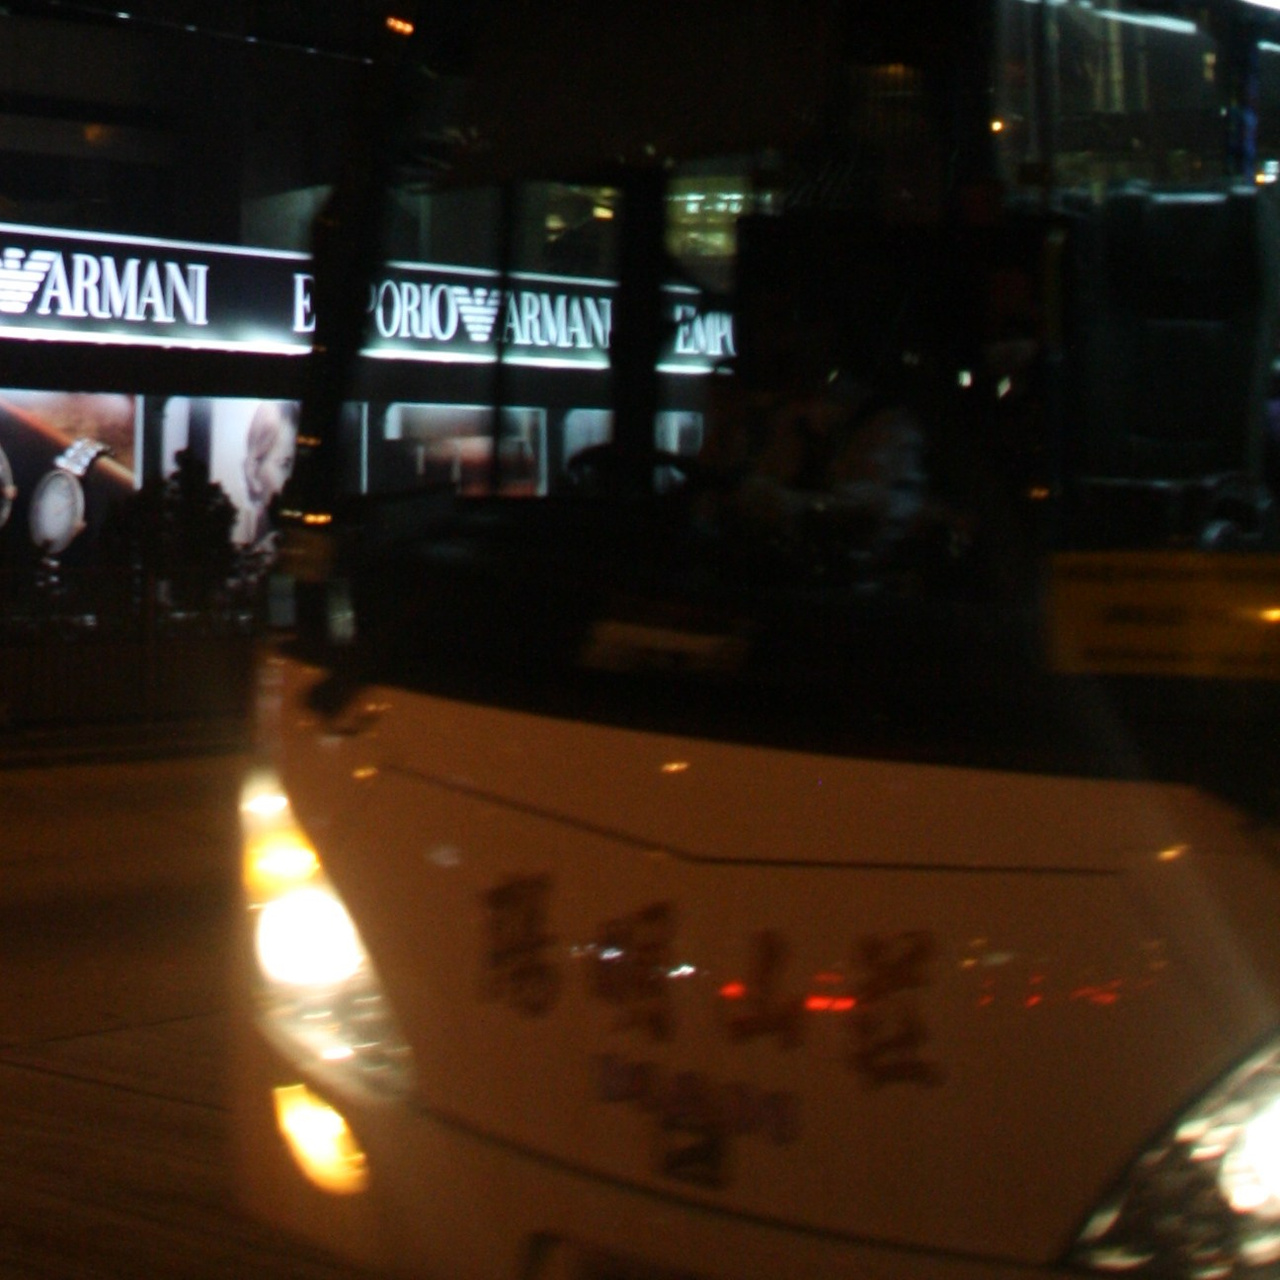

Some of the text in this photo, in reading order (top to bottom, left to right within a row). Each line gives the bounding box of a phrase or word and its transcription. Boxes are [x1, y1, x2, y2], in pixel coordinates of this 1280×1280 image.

[37, 252, 209, 325] ARMANI
[293, 272, 612, 349] EORIO ARMAN
